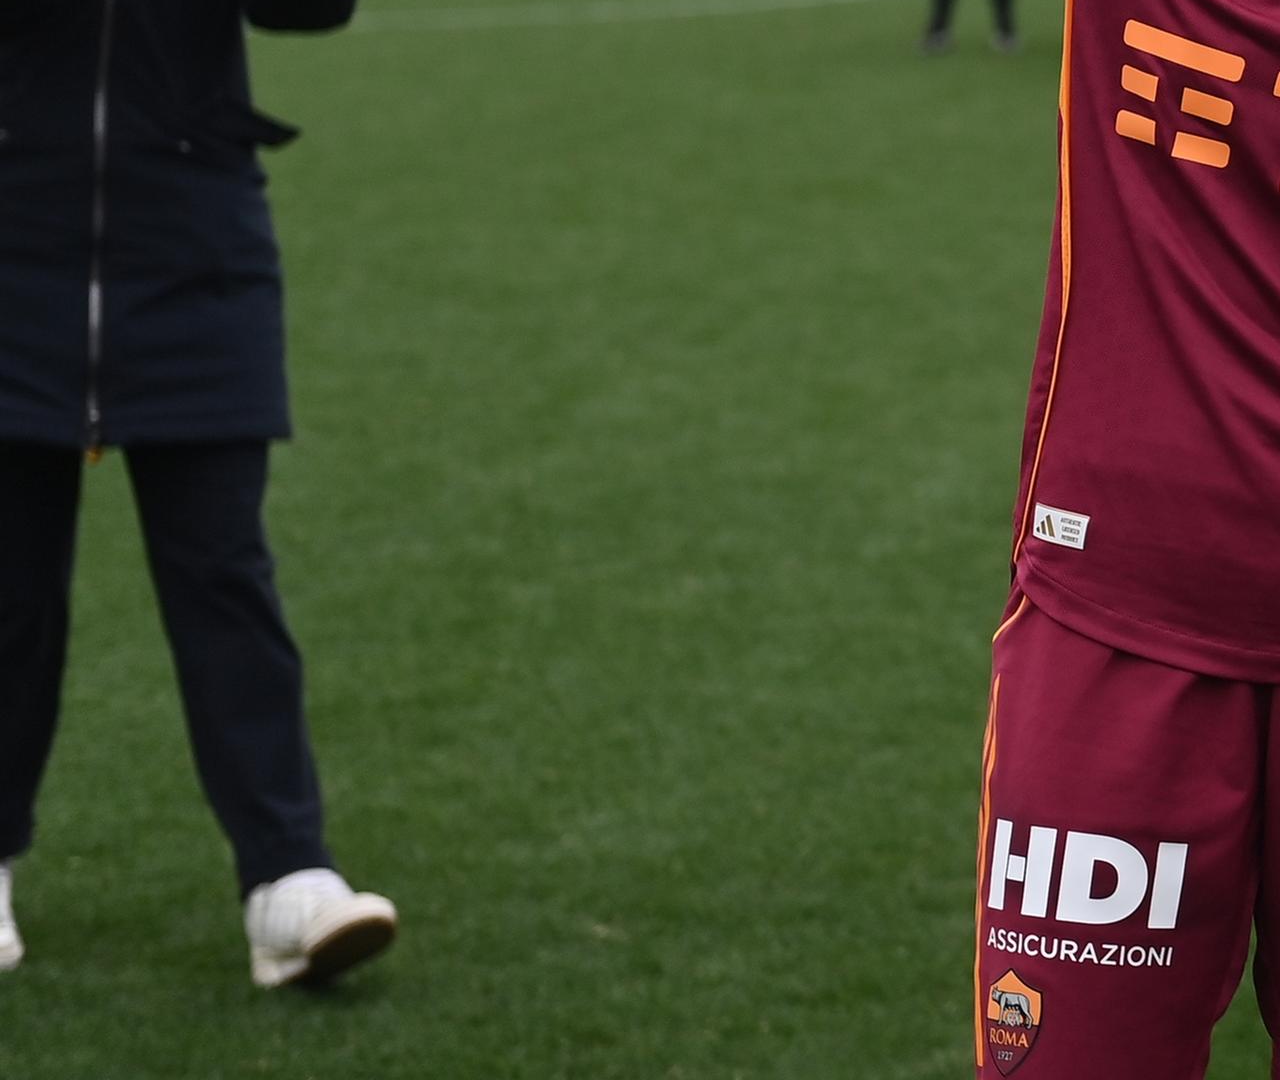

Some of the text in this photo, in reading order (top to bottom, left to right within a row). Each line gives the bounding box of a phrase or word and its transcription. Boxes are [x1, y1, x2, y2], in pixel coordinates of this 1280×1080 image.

[987, 818, 1189, 929] HDI
[987, 927, 1174, 967] ASSICURAZIONI
[989, 1027, 1030, 1048] ROMA
